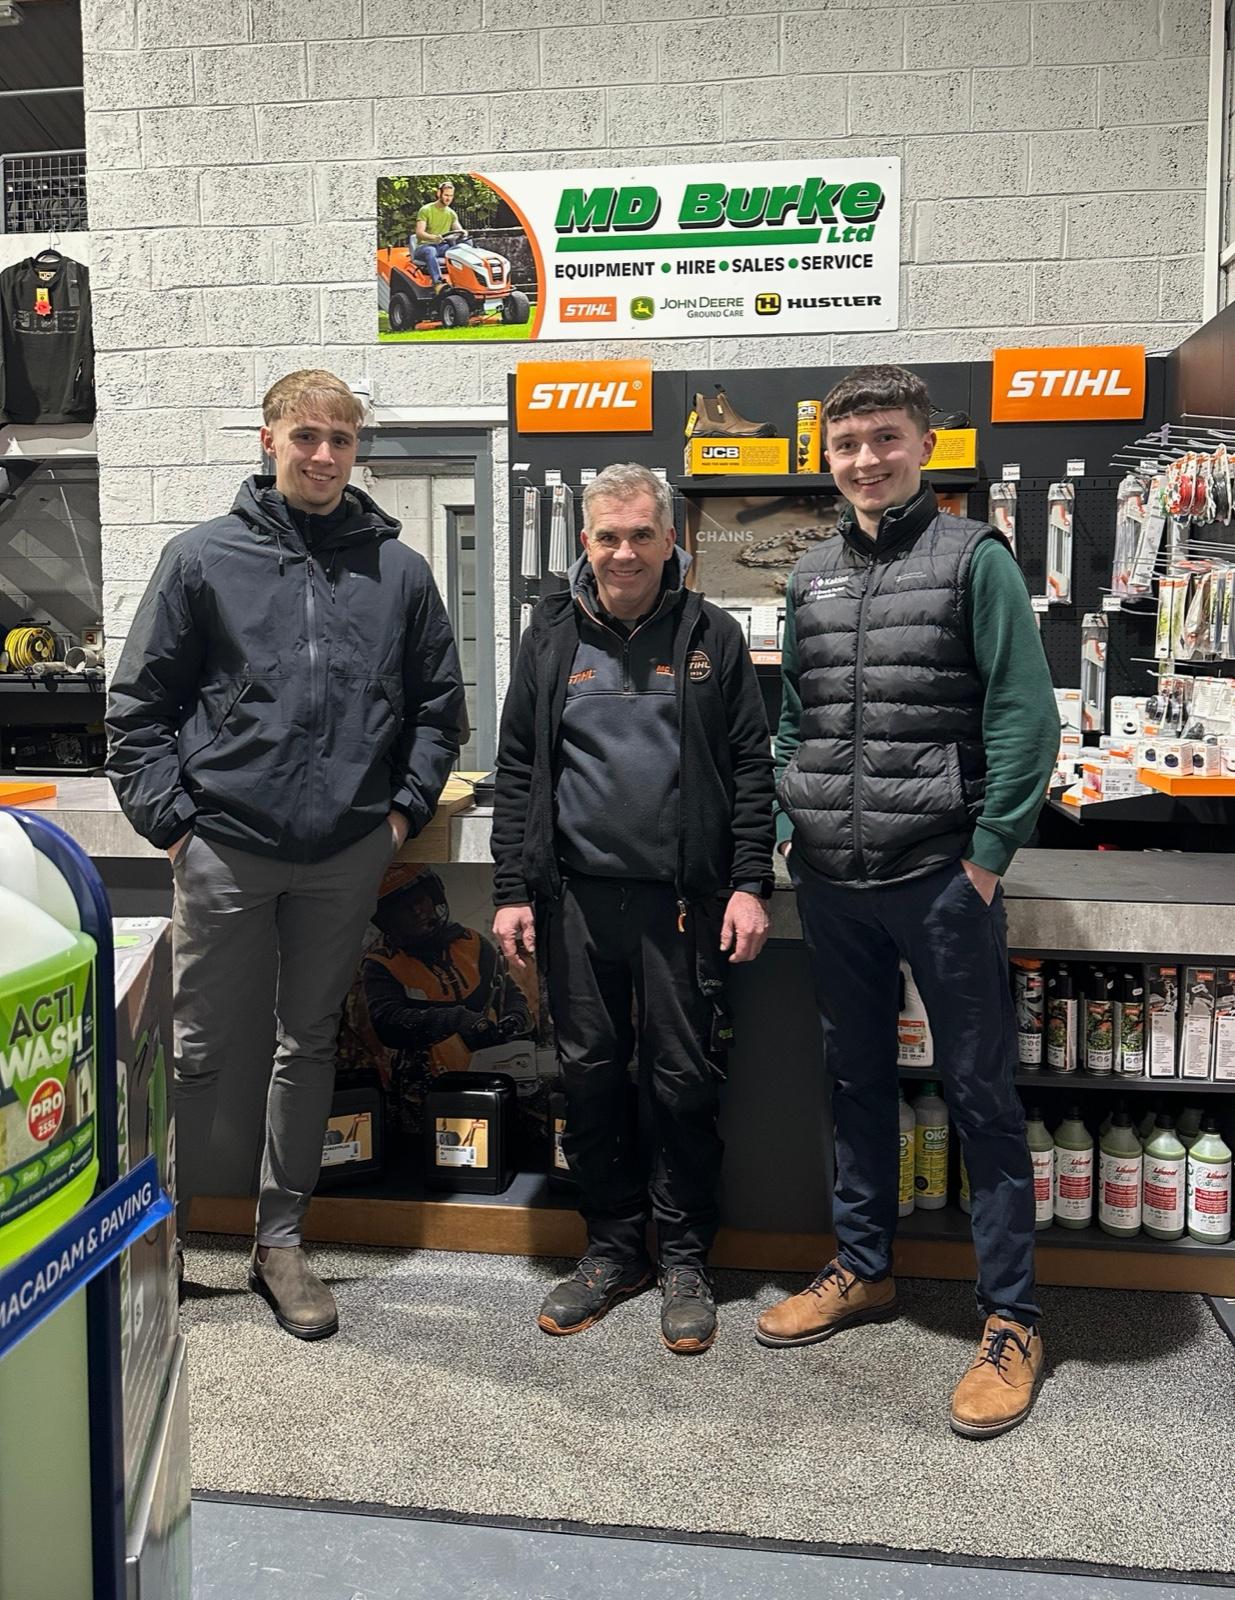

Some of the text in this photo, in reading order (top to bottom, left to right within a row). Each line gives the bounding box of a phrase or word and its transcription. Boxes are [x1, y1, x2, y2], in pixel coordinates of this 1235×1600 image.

[554, 177, 886, 234] MD Burke
[826, 224, 876, 244] Ltd
[555, 254, 873, 280] EQUIPMENT HIRE SALES SERVICE
[564, 303, 612, 317] STIHL
[660, 296, 745, 310] JOHN DEERE
[686, 308, 744, 319] GROUND CARE
[787, 295, 882, 309] HUSTLER
[1006, 369, 1132, 398] STIHL
[527, 382, 638, 409] STIHL
[703, 447, 739, 458] JCB
[695, 530, 754, 542] CHAINS
[689, 661, 711, 669] TIHL
[8, 984, 74, 1046] ACTI
[0, 1015, 83, 1089] WASH
[31, 1091, 62, 1123] PRO
[87, 1227, 98, 1254] &
[101, 1182, 152, 1243] PAVING
